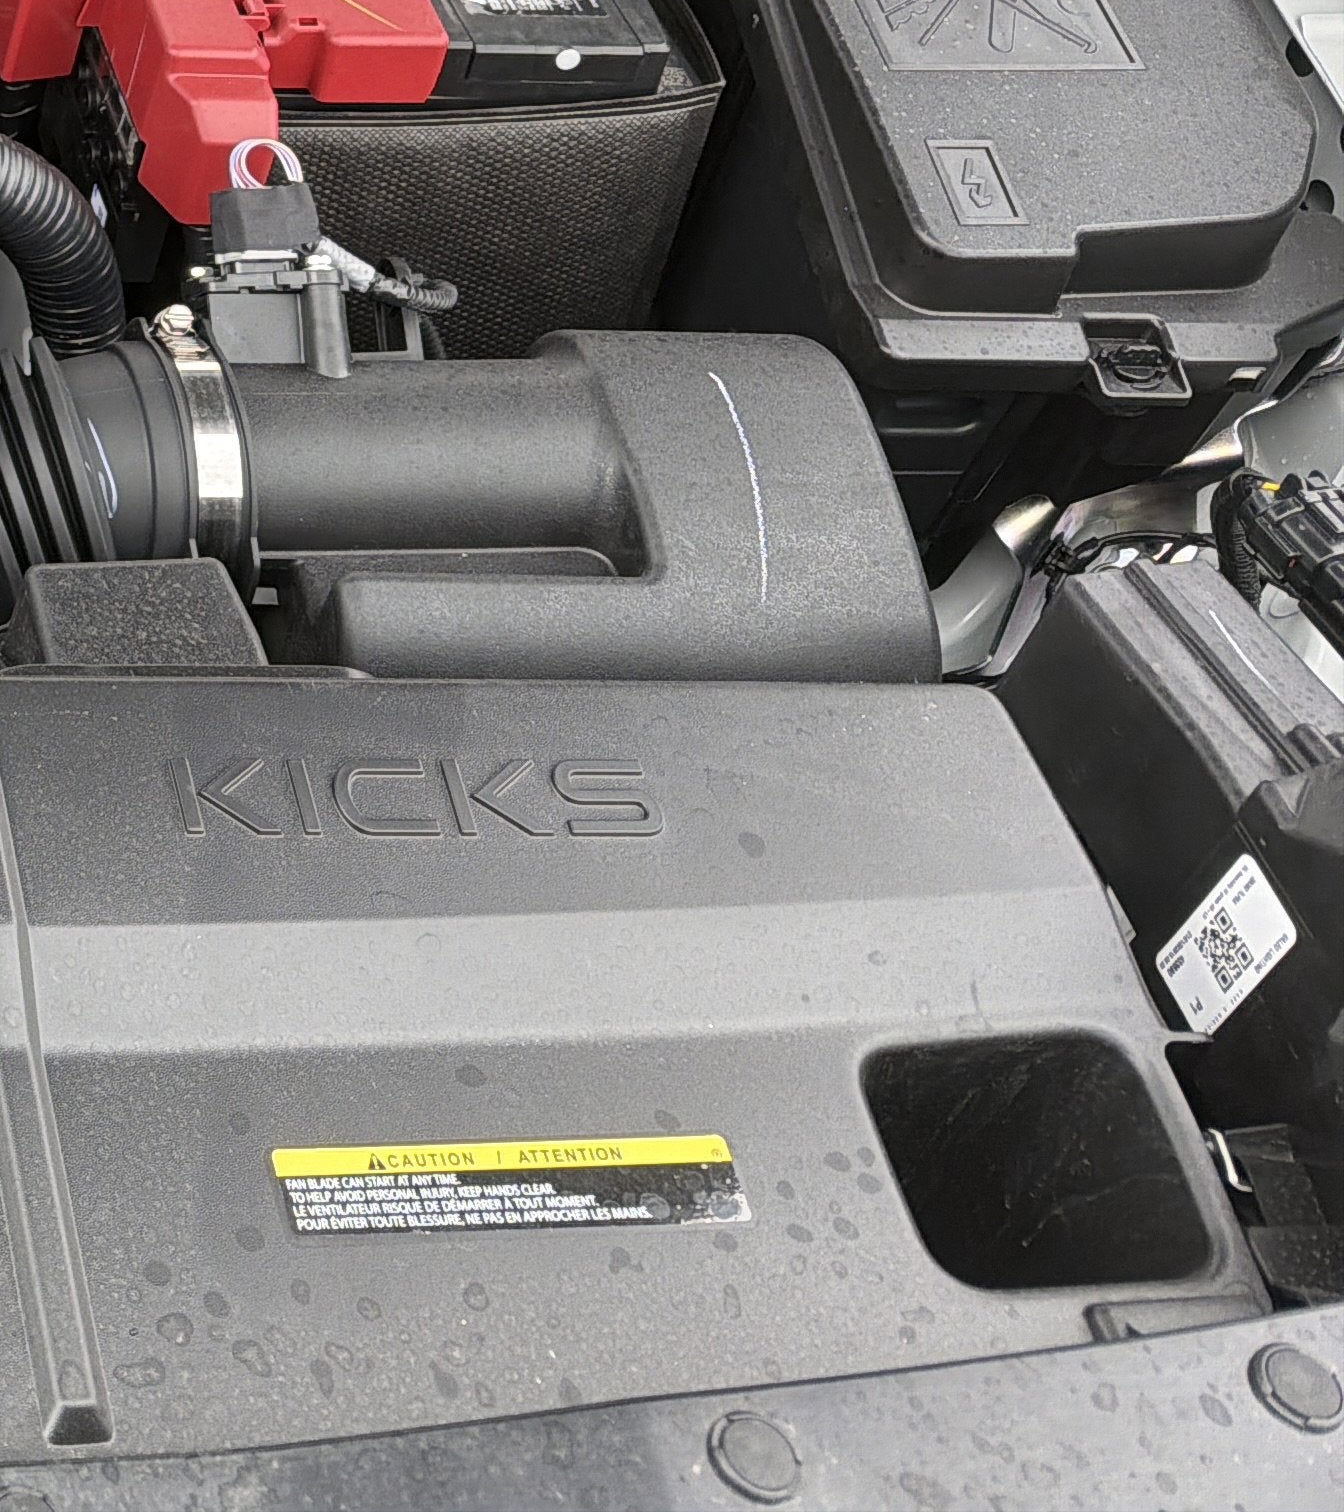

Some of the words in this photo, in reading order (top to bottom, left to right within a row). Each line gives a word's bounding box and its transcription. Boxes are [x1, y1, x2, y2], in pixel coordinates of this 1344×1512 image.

[167, 757, 666, 838] KICKS
[1189, 995, 1204, 1016] P1
[387, 1152, 475, 1168] CAUTION
[518, 1147, 623, 1165] ATTENTION
[284, 1178, 307, 1190] FAN
[307, 1177, 340, 1190] BLADE
[341, 1176, 364, 1189] CAN
[365, 1175, 396, 1188] START
[397, 1175, 410, 1187] AT
[412, 1174, 435, 1187] ANY
[434, 1173, 462, 1186] TIME.
[289, 1191, 305, 1204] TO
[306, 1191, 332, 1203] HELP
[333, 1190, 366, 1202] AVOID
[366, 1188, 420, 1201] PERSONAL
[457, 1185, 483, 1198] KEEP
[483, 1184, 521, 1197] HANDS
[520, 1183, 557, 1196] CLEAR.
[292, 1205, 309, 1218] LE
[308, 1203, 382, 1217] VENTILATEUR
[382, 1202, 424, 1216] RISQUE
[423, 1200, 441, 1214] DE
[441, 1198, 503, 1213] DÉMARRER
[513, 1197, 544, 1210] TOUT
[544, 1194, 600, 1209] MOMENT.
[296, 1217, 330, 1231] POUR
[329, 1216, 369, 1230] ÉVITER
[369, 1215, 407, 1228] TOUTE
[465, 1213, 483, 1226] NE
[482, 1212, 505, 1225] PAS
[504, 1211, 523, 1224] EN
[522, 1208, 590, 1223] APPROCHER
[590, 1207, 612, 1221] LES
